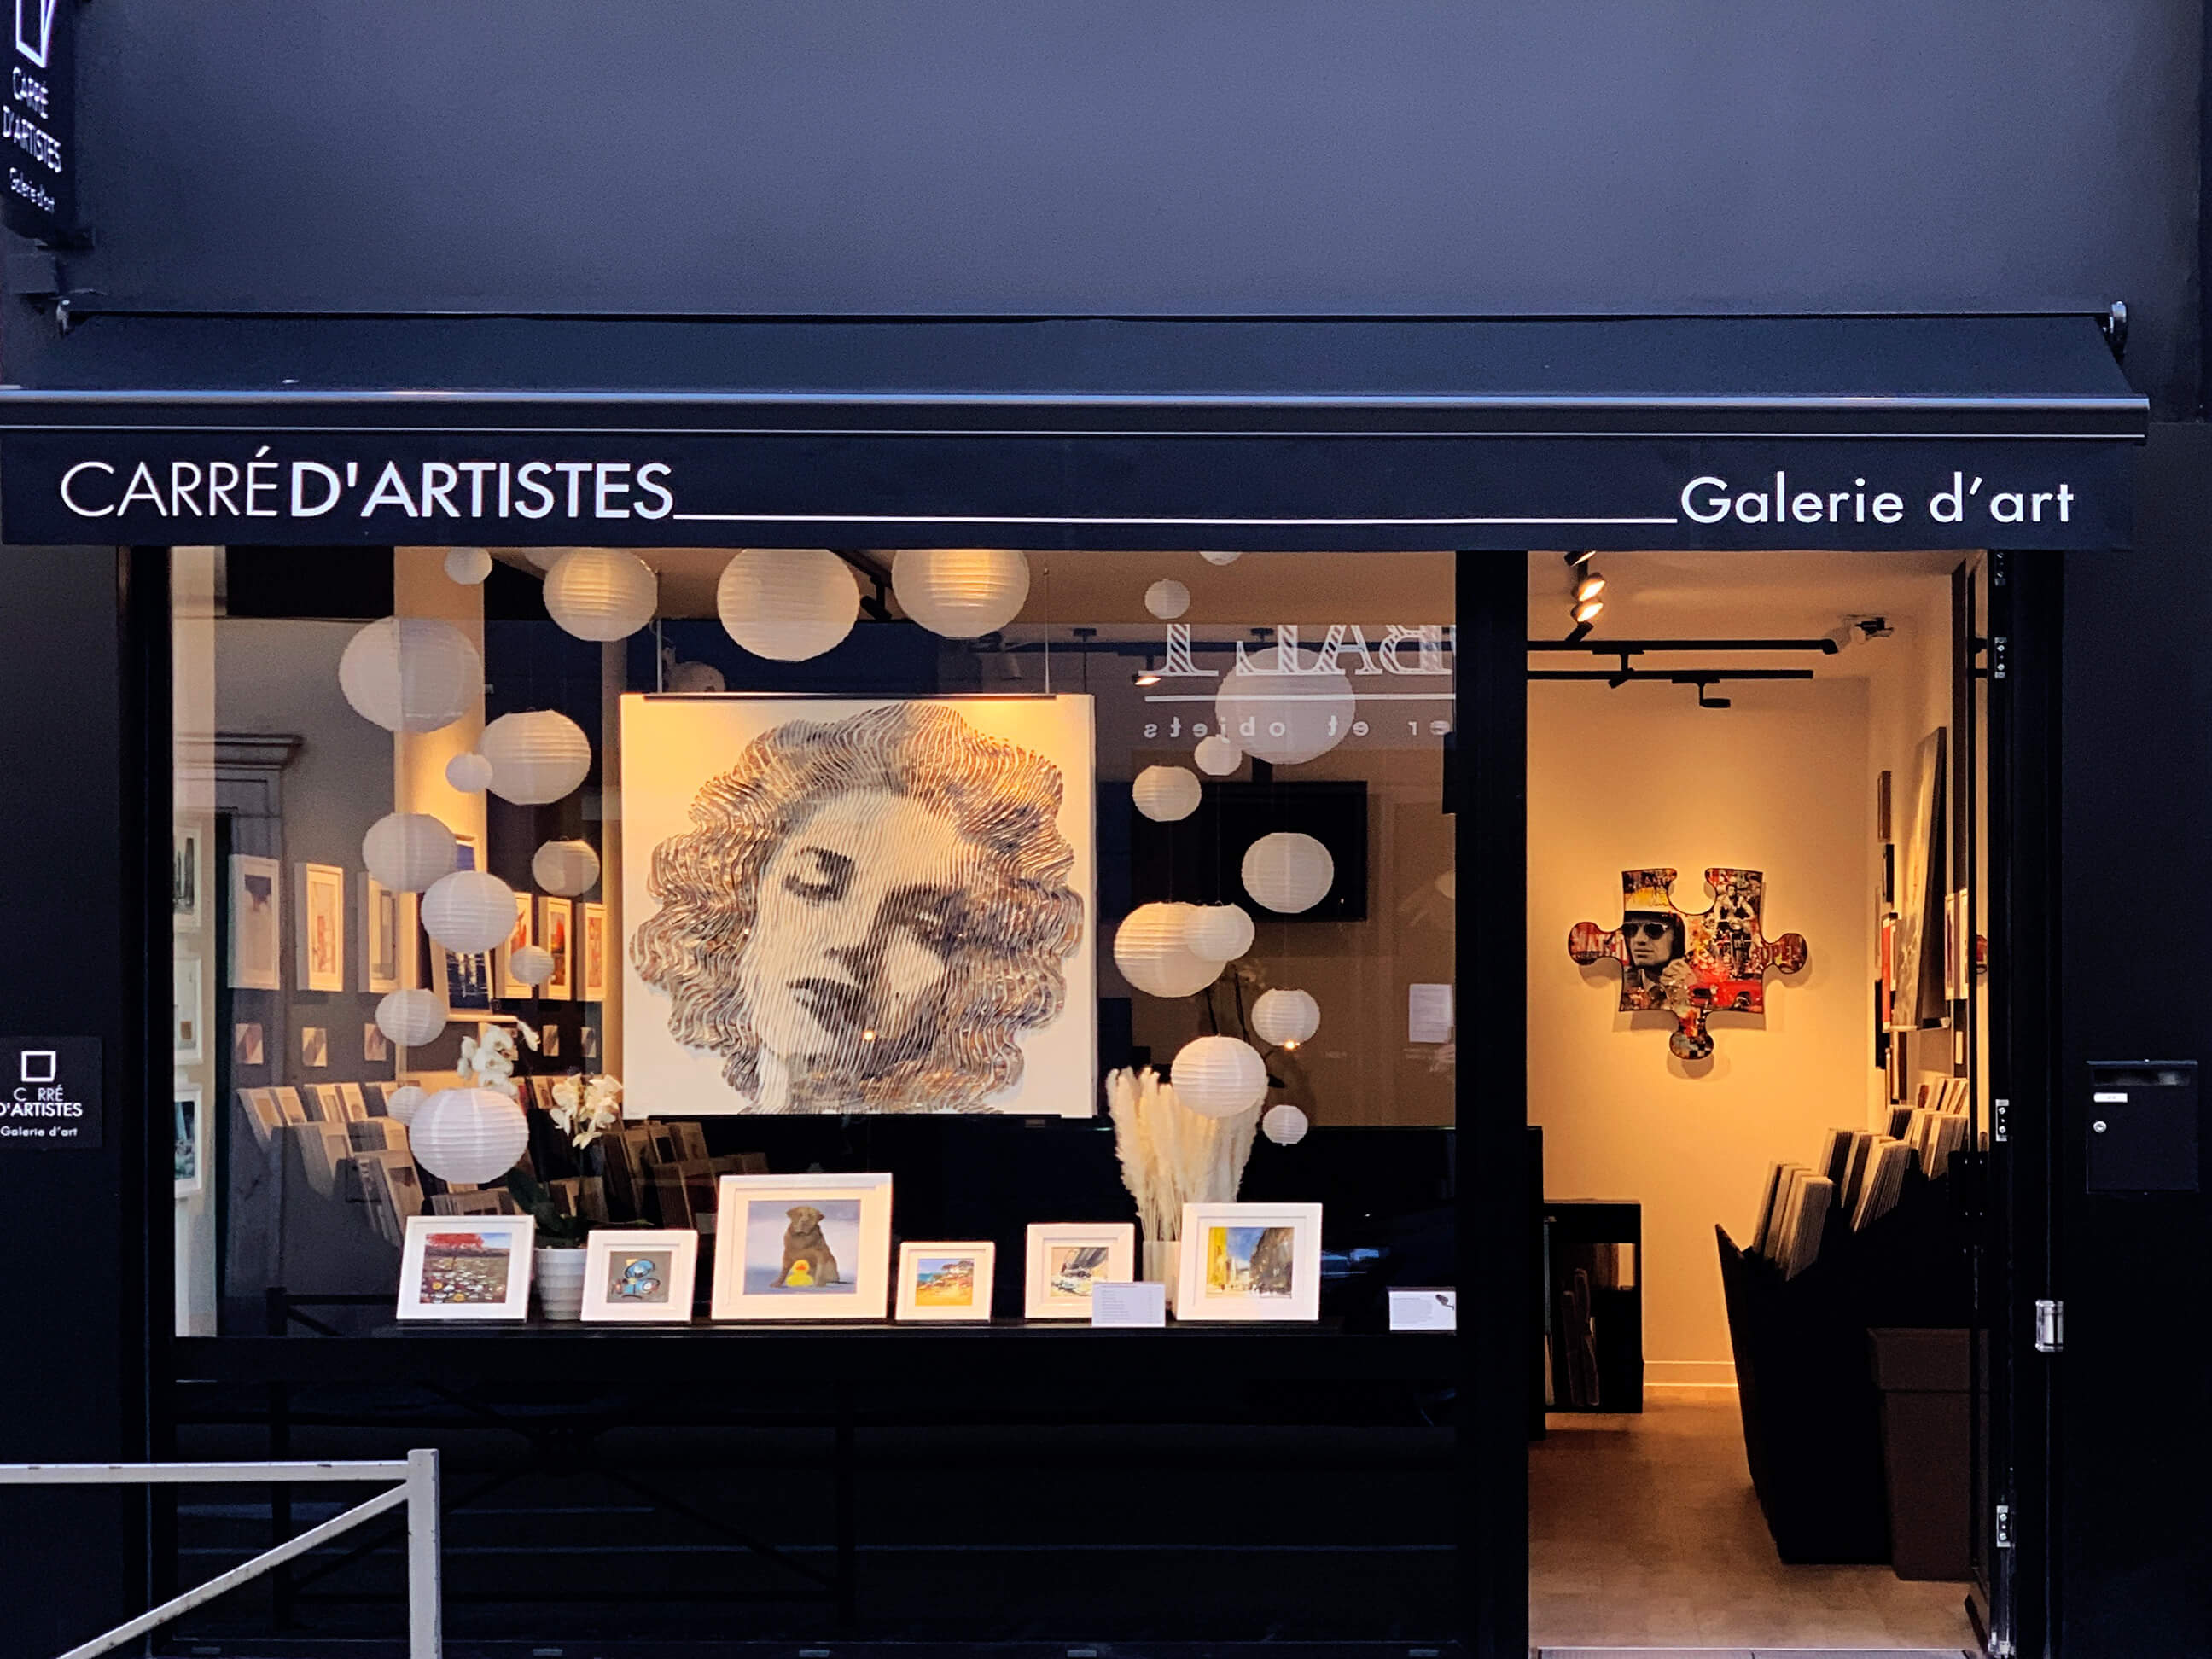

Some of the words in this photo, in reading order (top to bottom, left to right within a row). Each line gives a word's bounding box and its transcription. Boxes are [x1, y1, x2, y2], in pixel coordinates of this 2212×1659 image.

[61, 446, 279, 517] CARRÉ
[291, 461, 674, 519] D'ARTISTES
[1680, 470, 1904, 523] Galerie
[1929, 470, 2075, 523] d'art
[13, 1084, 64, 1102] CRRÉ
[0, 1126, 45, 1137] Galerie
[49, 1126, 78, 1137] d'art
